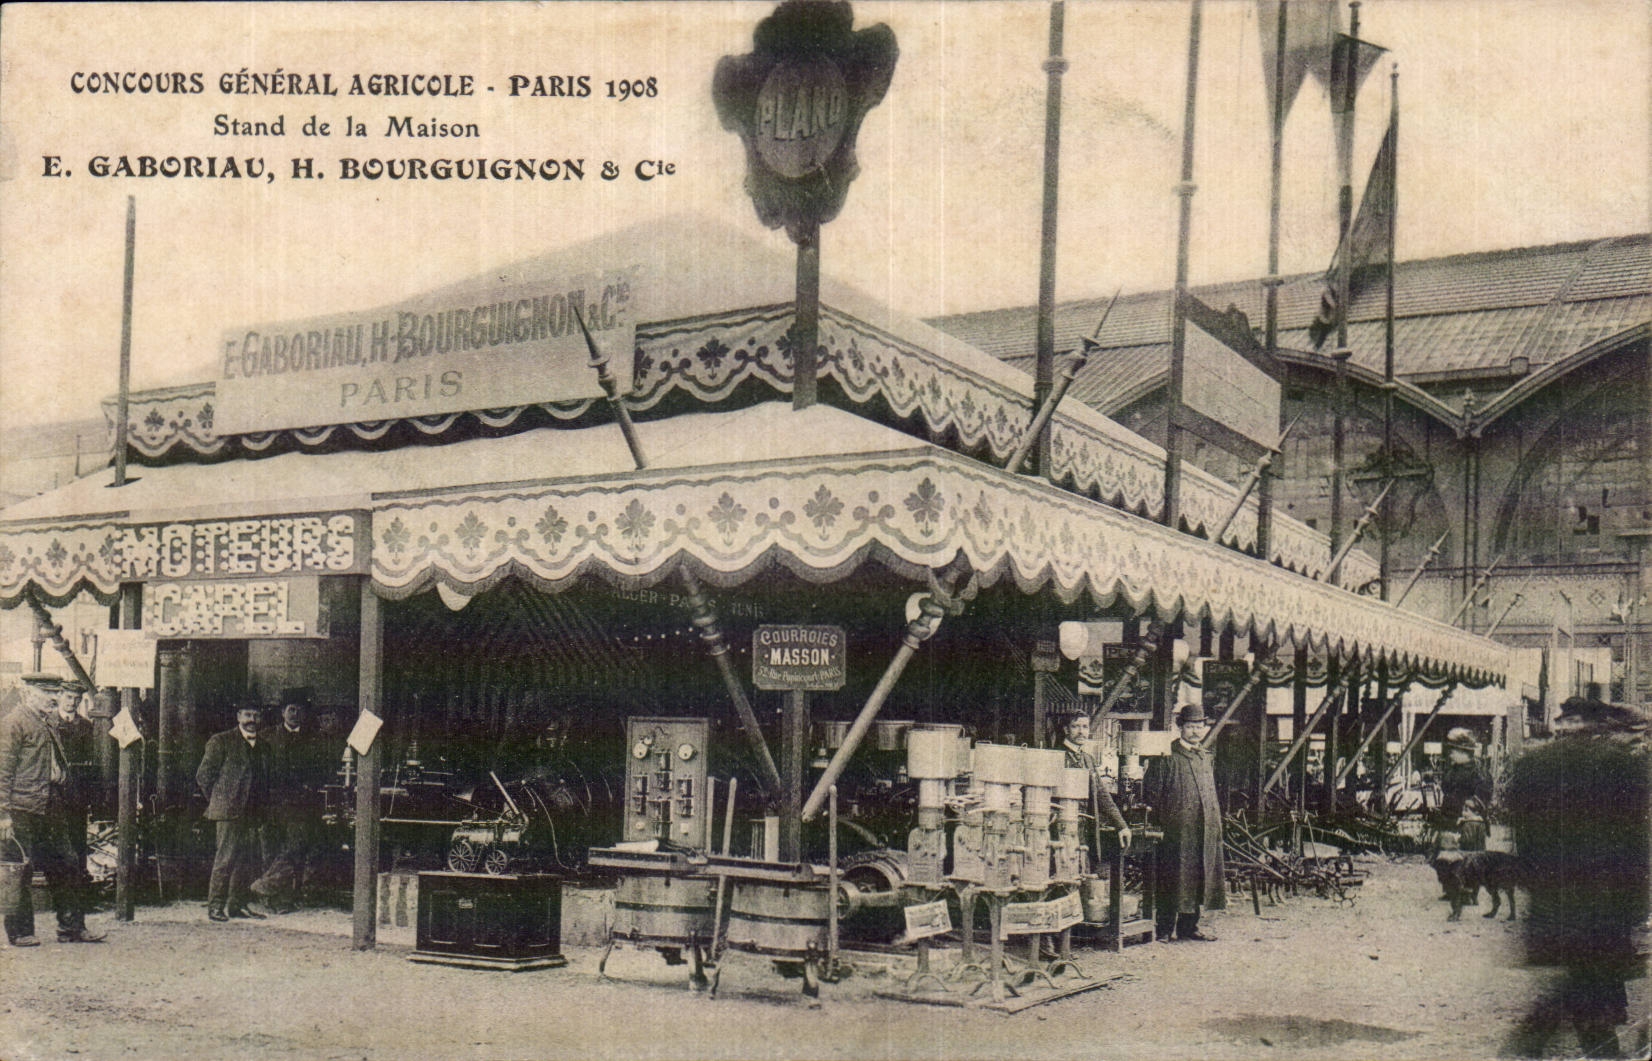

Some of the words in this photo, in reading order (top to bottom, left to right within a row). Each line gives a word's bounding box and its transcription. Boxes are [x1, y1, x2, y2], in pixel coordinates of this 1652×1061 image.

[340, 370, 463, 408] PARIS
[120, 515, 354, 578] MOTEURS
[154, 582, 305, 635] CAPEL
[669, 593, 717, 609] PAS
[760, 629, 839, 647] COURROIES
[769, 647, 830, 666] MASSON
